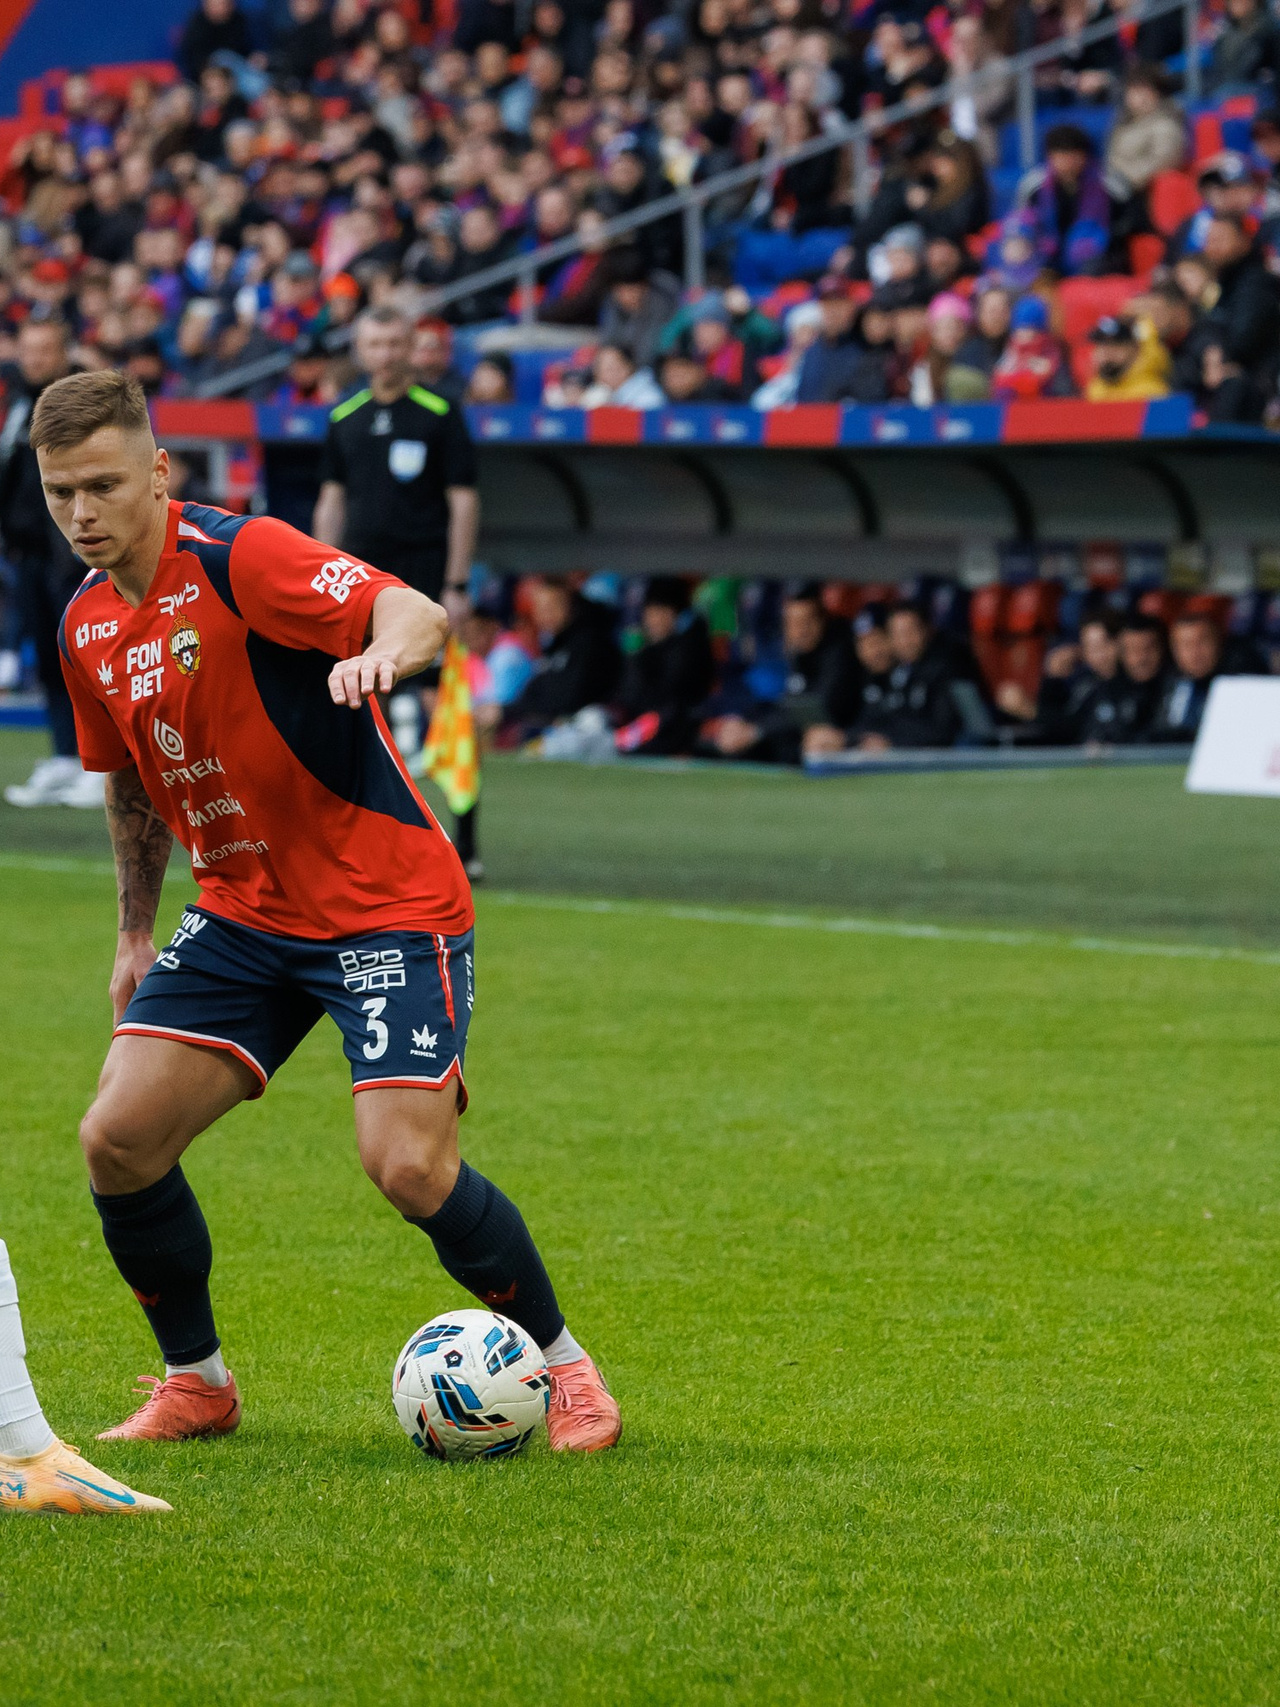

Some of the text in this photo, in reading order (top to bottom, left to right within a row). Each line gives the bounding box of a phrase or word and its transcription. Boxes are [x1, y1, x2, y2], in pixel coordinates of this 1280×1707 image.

[310, 556, 355, 595] FON
[327, 565, 371, 604] BET
[91, 620, 118, 641] ПСБ
[171, 629, 199, 655] ЦСКА
[126, 637, 162, 675] FON
[131, 666, 165, 702] BET
[181, 911, 208, 935] ON
[361, 996, 389, 1060] 3
[410, 1048, 437, 1059] PRIMERA
